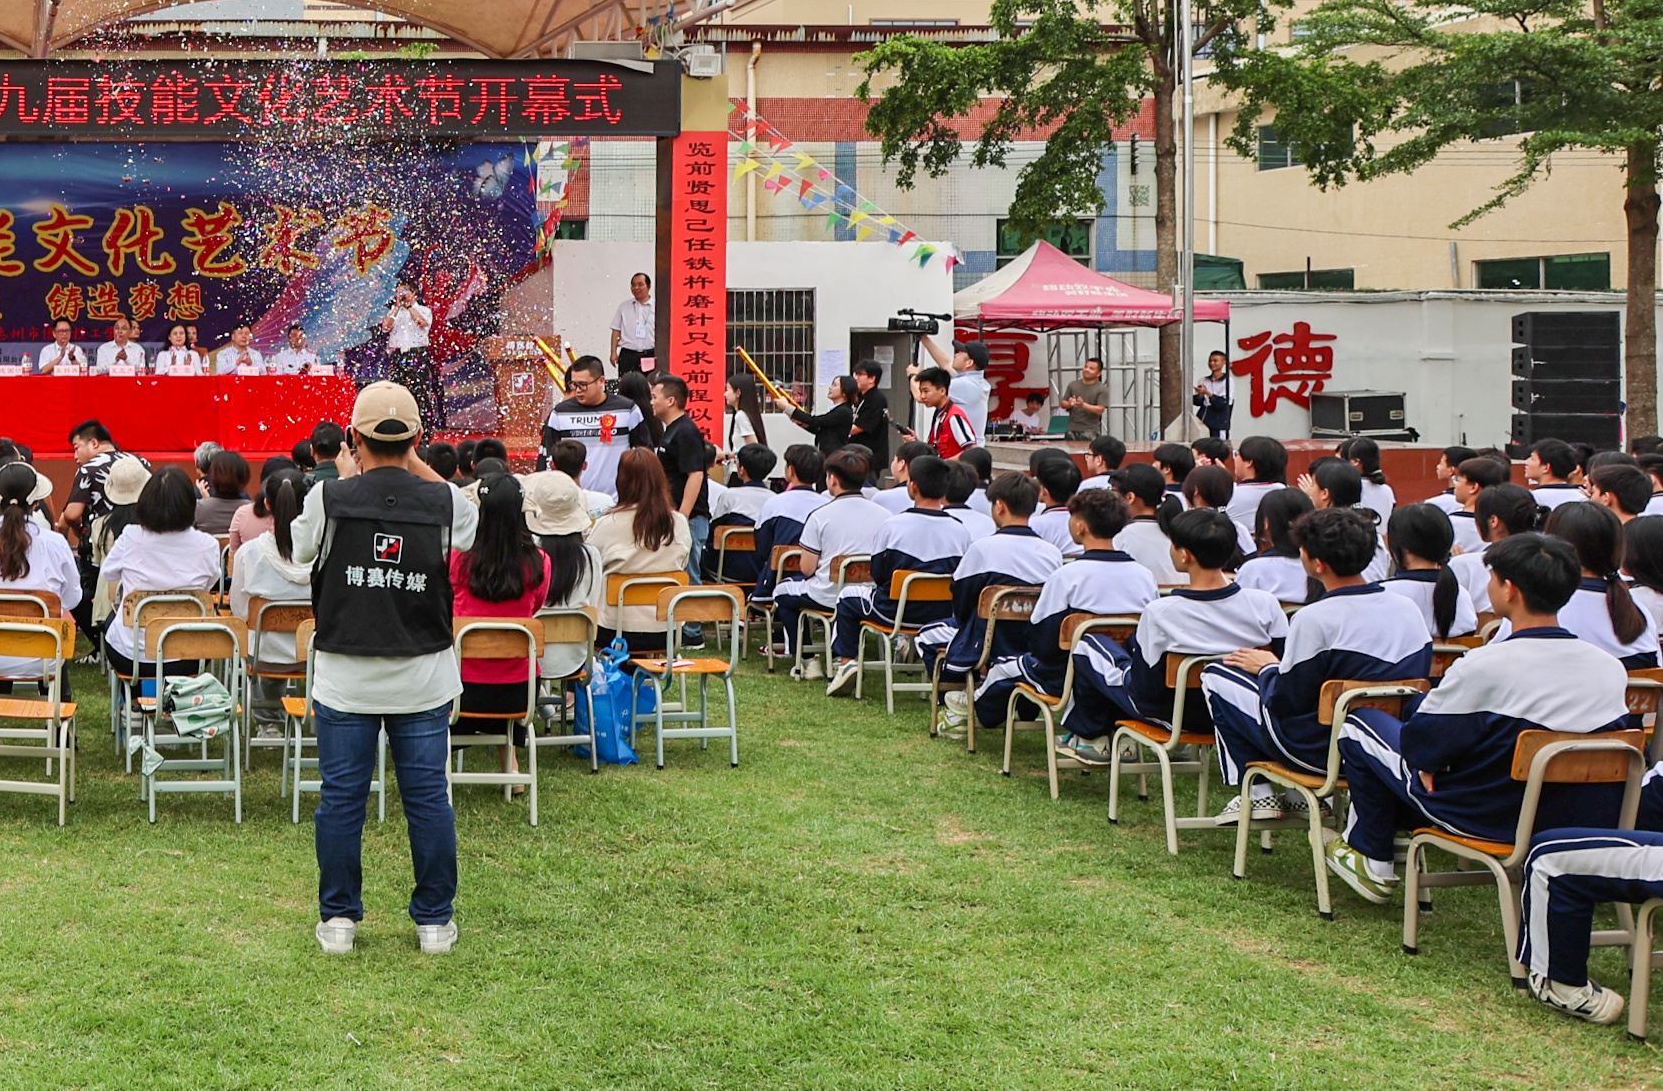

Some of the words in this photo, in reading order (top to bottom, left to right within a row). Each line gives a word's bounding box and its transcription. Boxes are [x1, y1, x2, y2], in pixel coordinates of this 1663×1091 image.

[44, 280, 206, 323] 铸造梦想
[1230, 321, 1338, 418] 德
[344, 564, 428, 593] 博赛传媒
